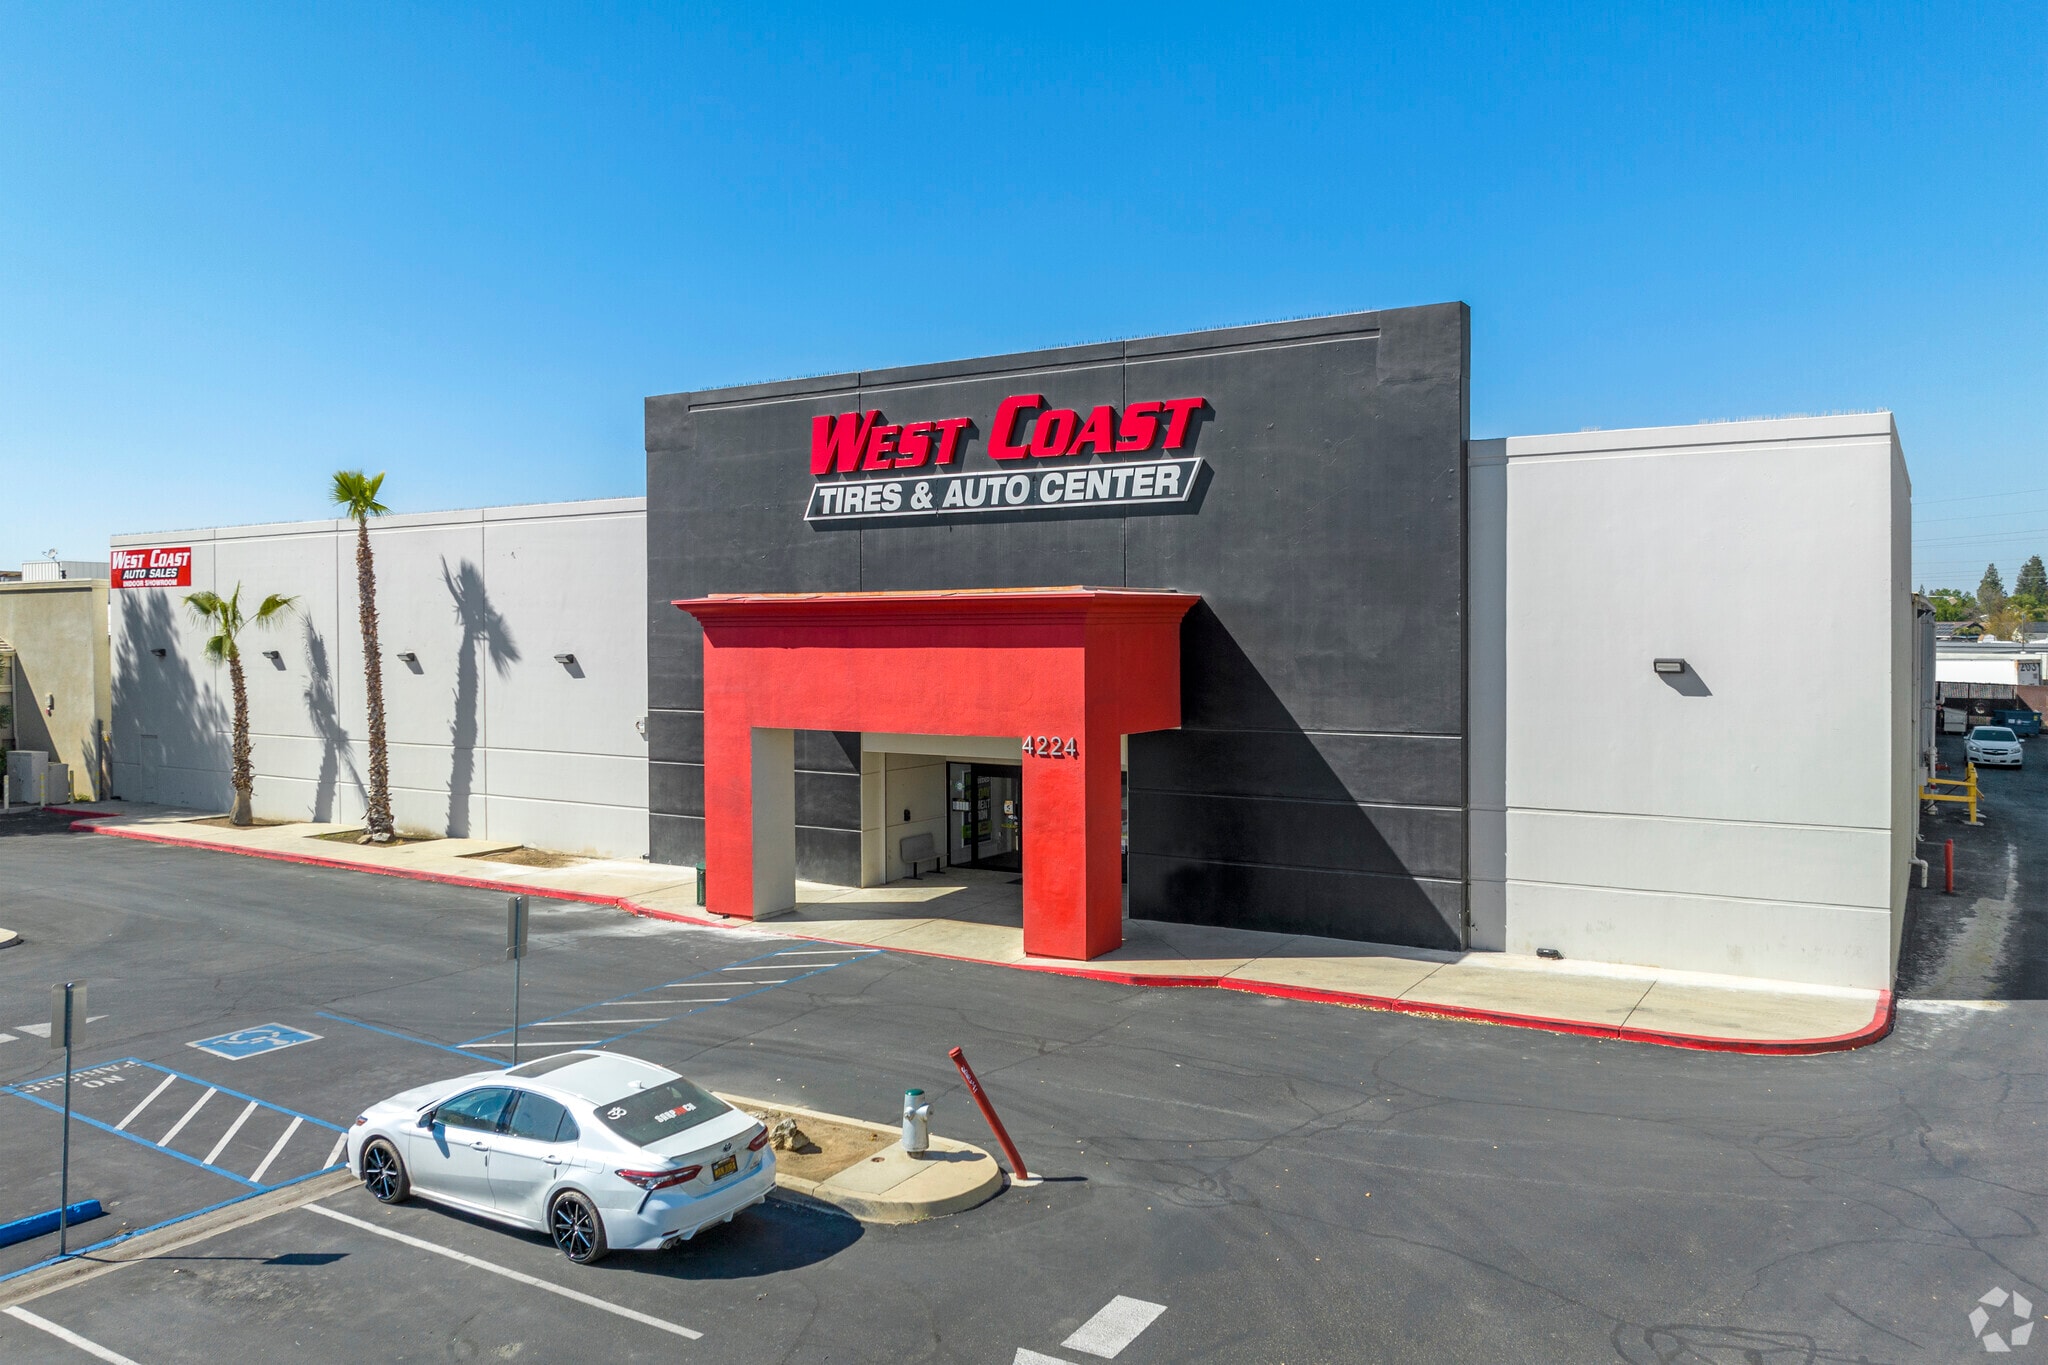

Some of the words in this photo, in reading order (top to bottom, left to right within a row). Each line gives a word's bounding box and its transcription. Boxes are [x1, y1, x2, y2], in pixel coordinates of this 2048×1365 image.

[810, 409, 972, 476] WEST
[987, 393, 1208, 461] COAST
[819, 483, 902, 515] TIRES
[910, 480, 934, 510] &
[942, 471, 1030, 509] AUTO
[1038, 465, 1181, 503] CENTER
[112, 551, 146, 570] WEST
[150, 549, 191, 568] COAST
[123, 569, 146, 579] AUTO
[149, 567, 178, 578] SALES
[1022, 735, 1077, 757] 4224
[82, 1075, 126, 1088] NO
